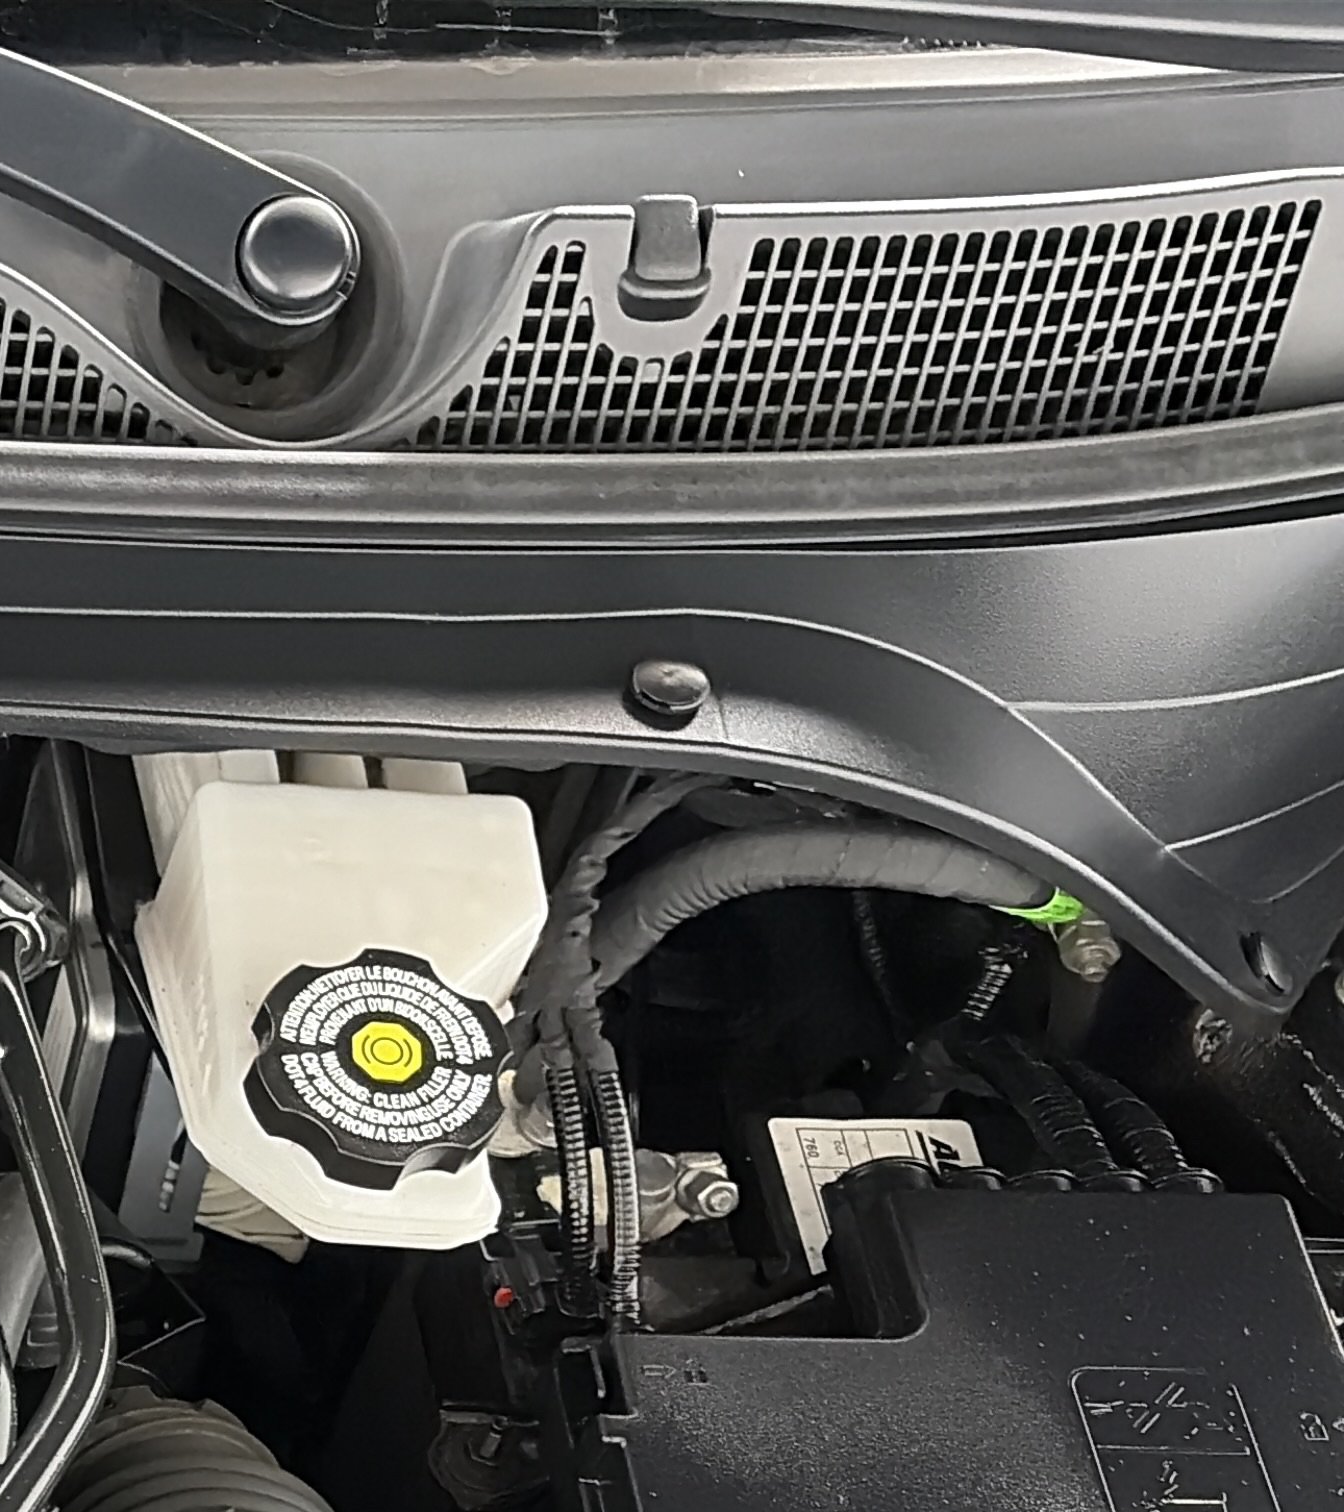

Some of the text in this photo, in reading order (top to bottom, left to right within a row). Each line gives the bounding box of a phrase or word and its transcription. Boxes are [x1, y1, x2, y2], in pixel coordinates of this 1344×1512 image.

[366, 966, 382, 980] LE
[420, 996, 440, 1014] DE
[301, 1053, 324, 1077] CAP
[313, 1076, 362, 1116] BEFORE
[374, 1093, 421, 1109] CLEAN
[417, 1066, 452, 1102] FILLER
[333, 1112, 375, 1139] FROM
[375, 1126, 387, 1142] A
[389, 1122, 442, 1142] SEALED
[803, 1137, 819, 1159] 760
